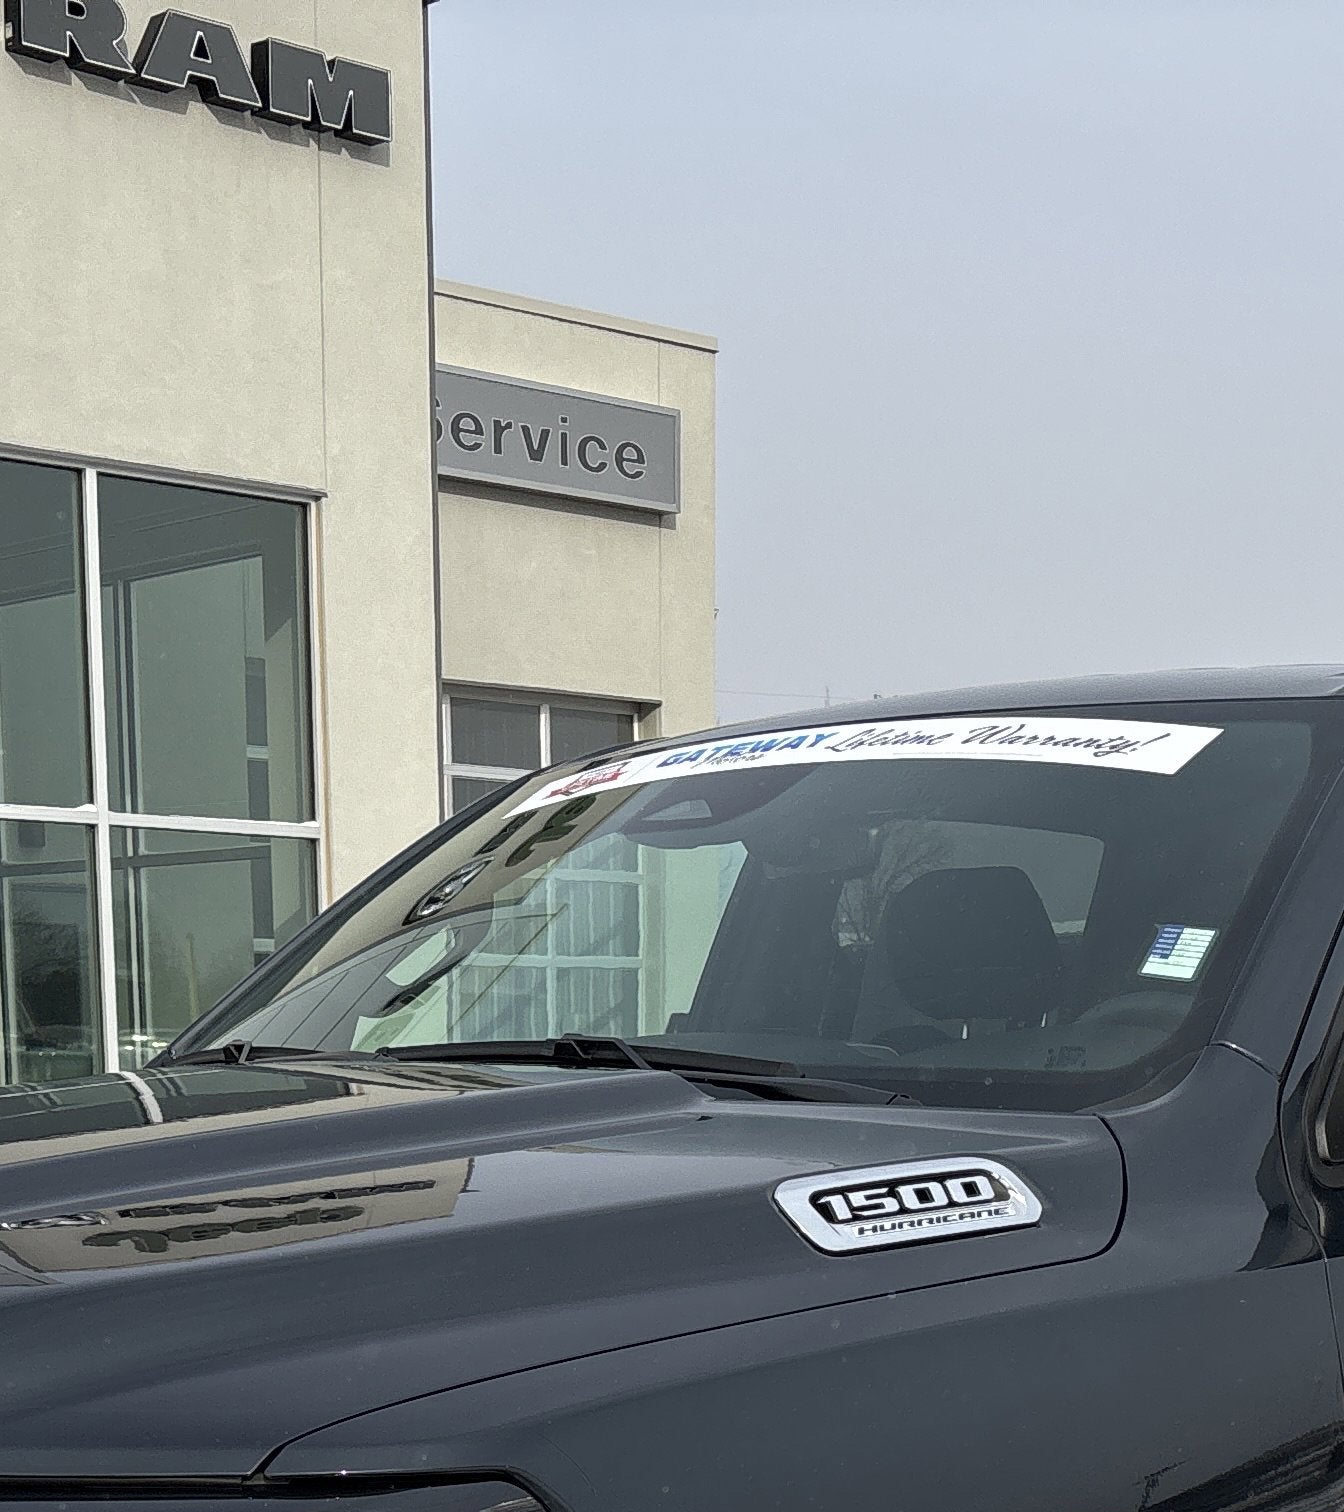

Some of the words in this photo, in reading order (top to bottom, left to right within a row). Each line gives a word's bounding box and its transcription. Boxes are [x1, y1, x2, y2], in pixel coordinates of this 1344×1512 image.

[6, 0, 393, 144] RAM
[436, 396, 647, 481] ervice
[656, 732, 839, 768] GATEWAY
[828, 727, 954, 753] Lifetime
[961, 722, 1171, 757] Warranty!
[817, 1174, 996, 1222] 1500
[857, 1206, 1017, 1236] HURRICANE
